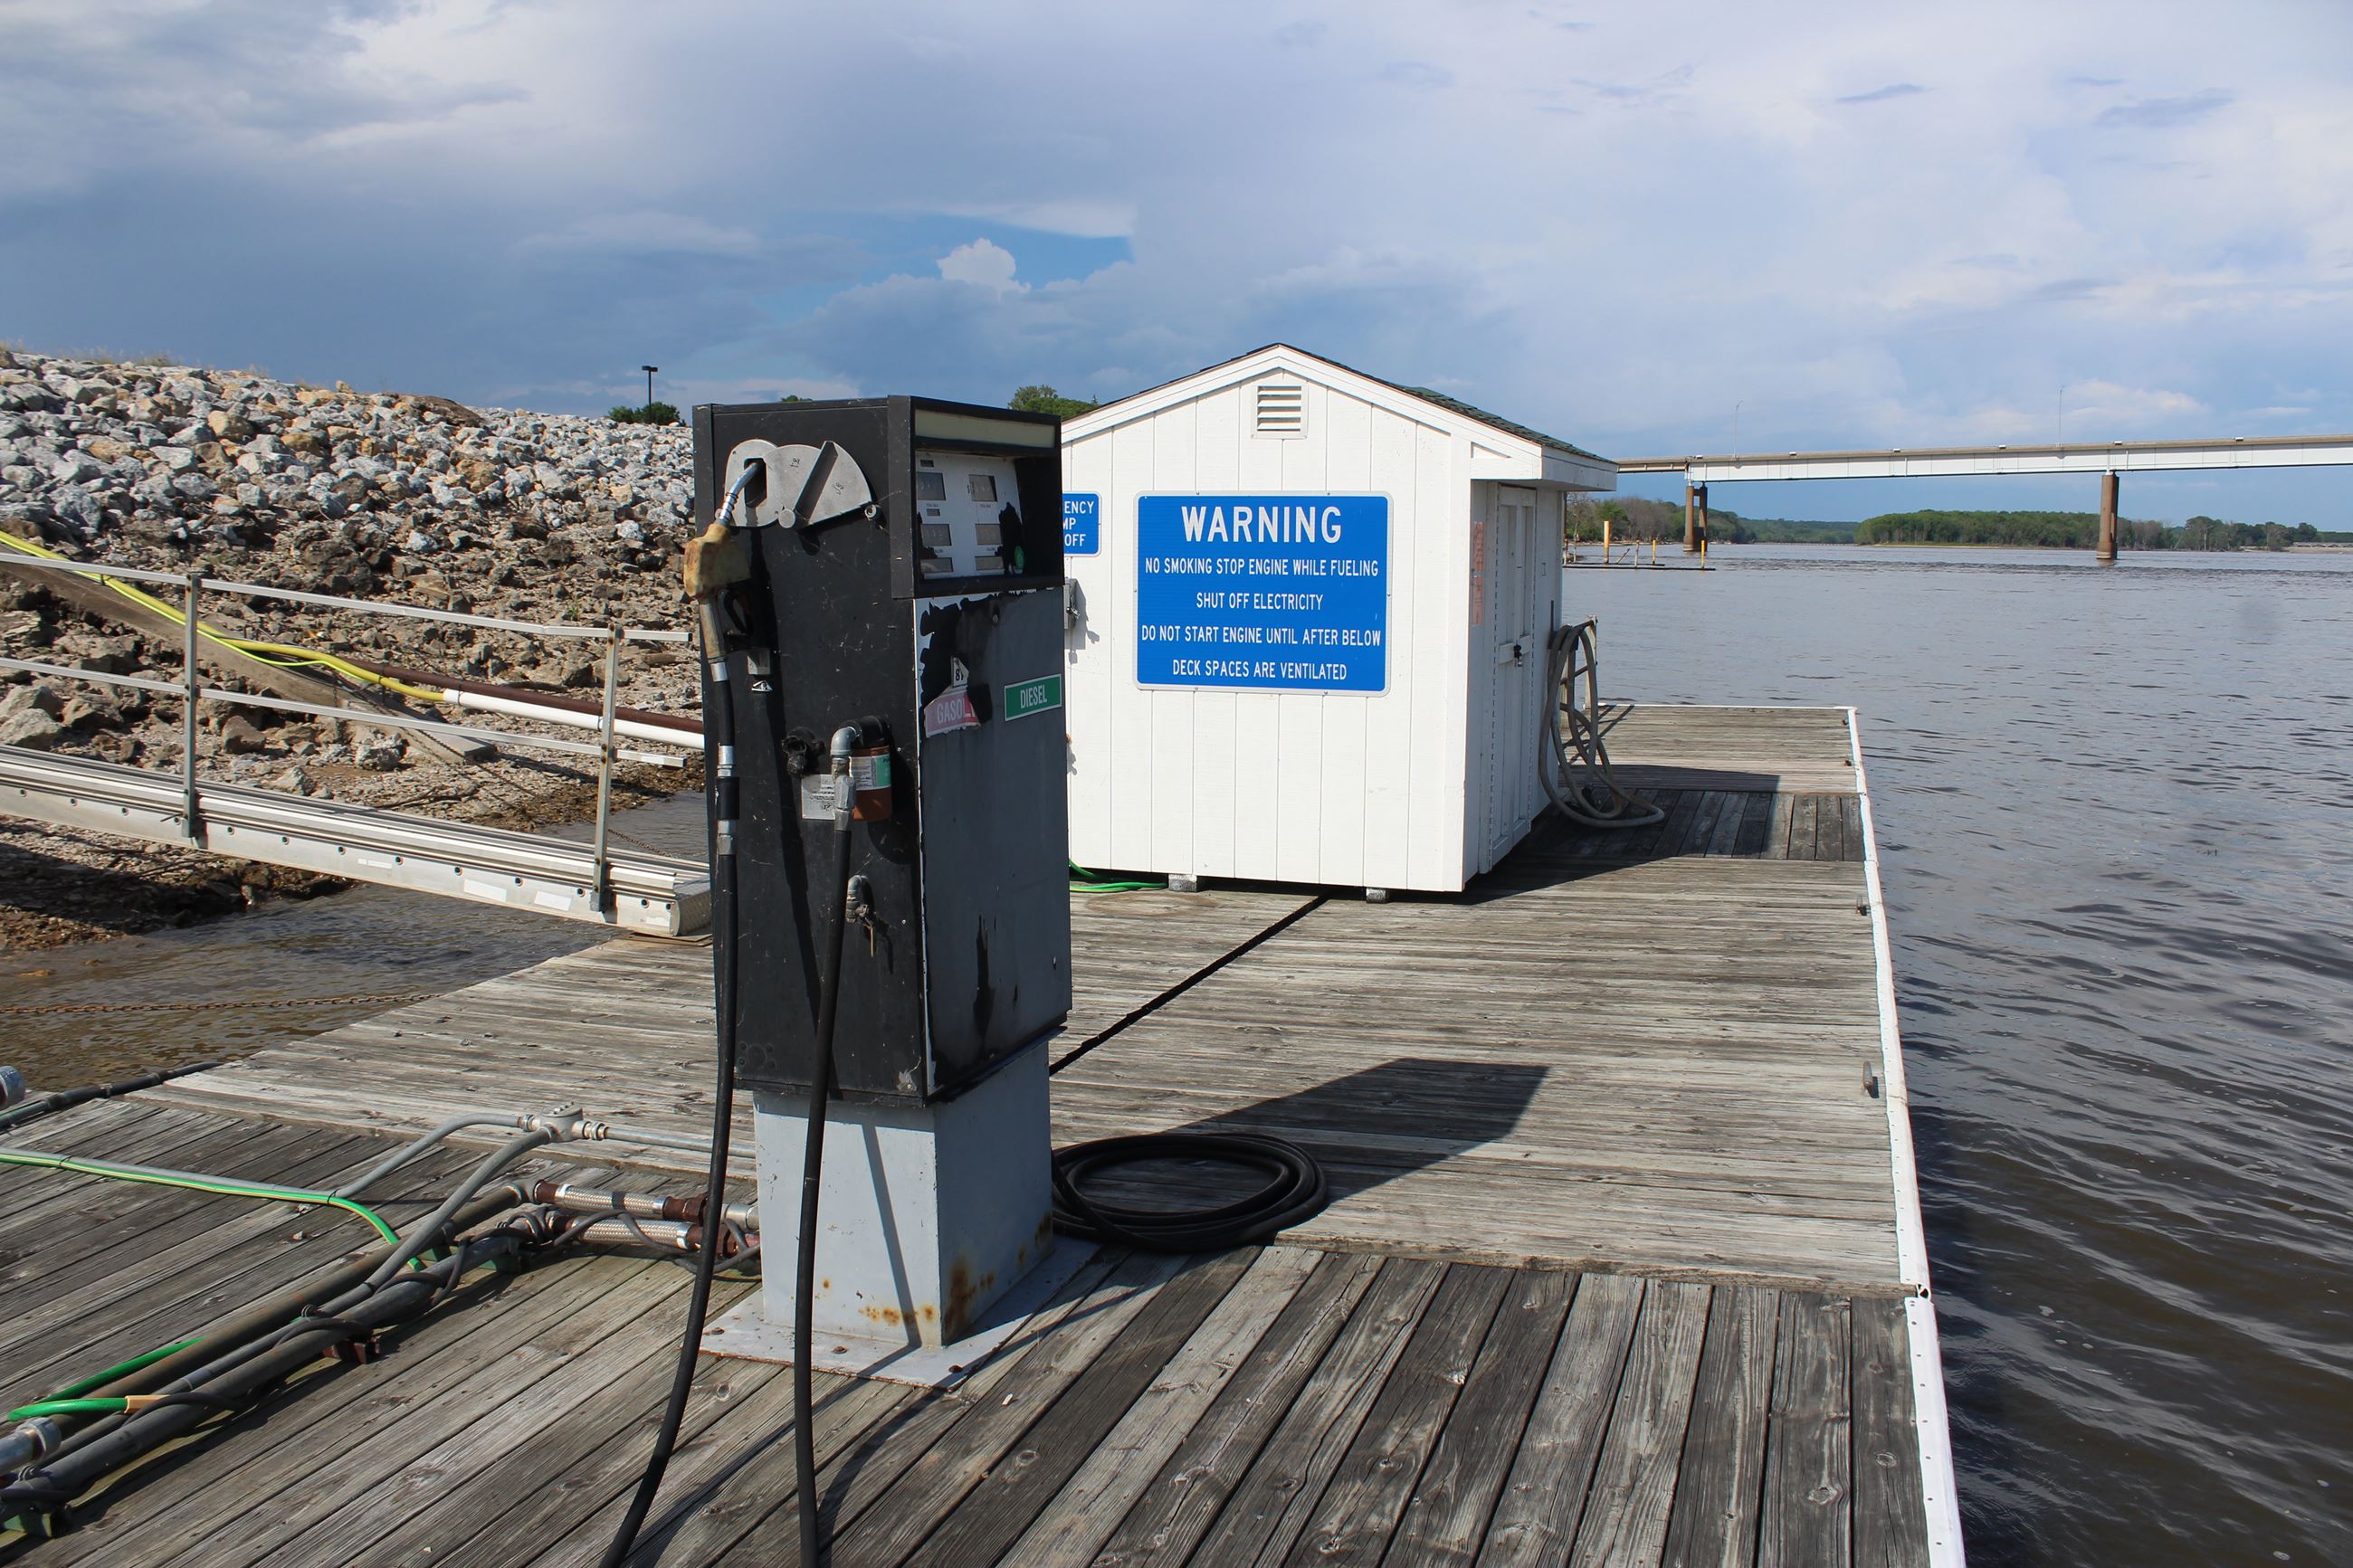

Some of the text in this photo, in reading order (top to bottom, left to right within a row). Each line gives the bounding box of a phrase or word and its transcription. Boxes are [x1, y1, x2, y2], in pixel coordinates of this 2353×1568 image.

[1181, 506, 1341, 543] WARNING
[1064, 533, 1086, 546] OFF
[1145, 557, 1379, 576] NO SMOKING STOP ENGINE WHILE FUELING
[1196, 592, 1323, 611] SHUT OFF ELECTRICITY
[1141, 624, 1381, 647] DO NOT START ENGINE UNTIL AFTER BELOW
[1173, 659, 1348, 680] DECK SPACES ARE VENTILATED
[1020, 684, 1048, 709] DIESEL
